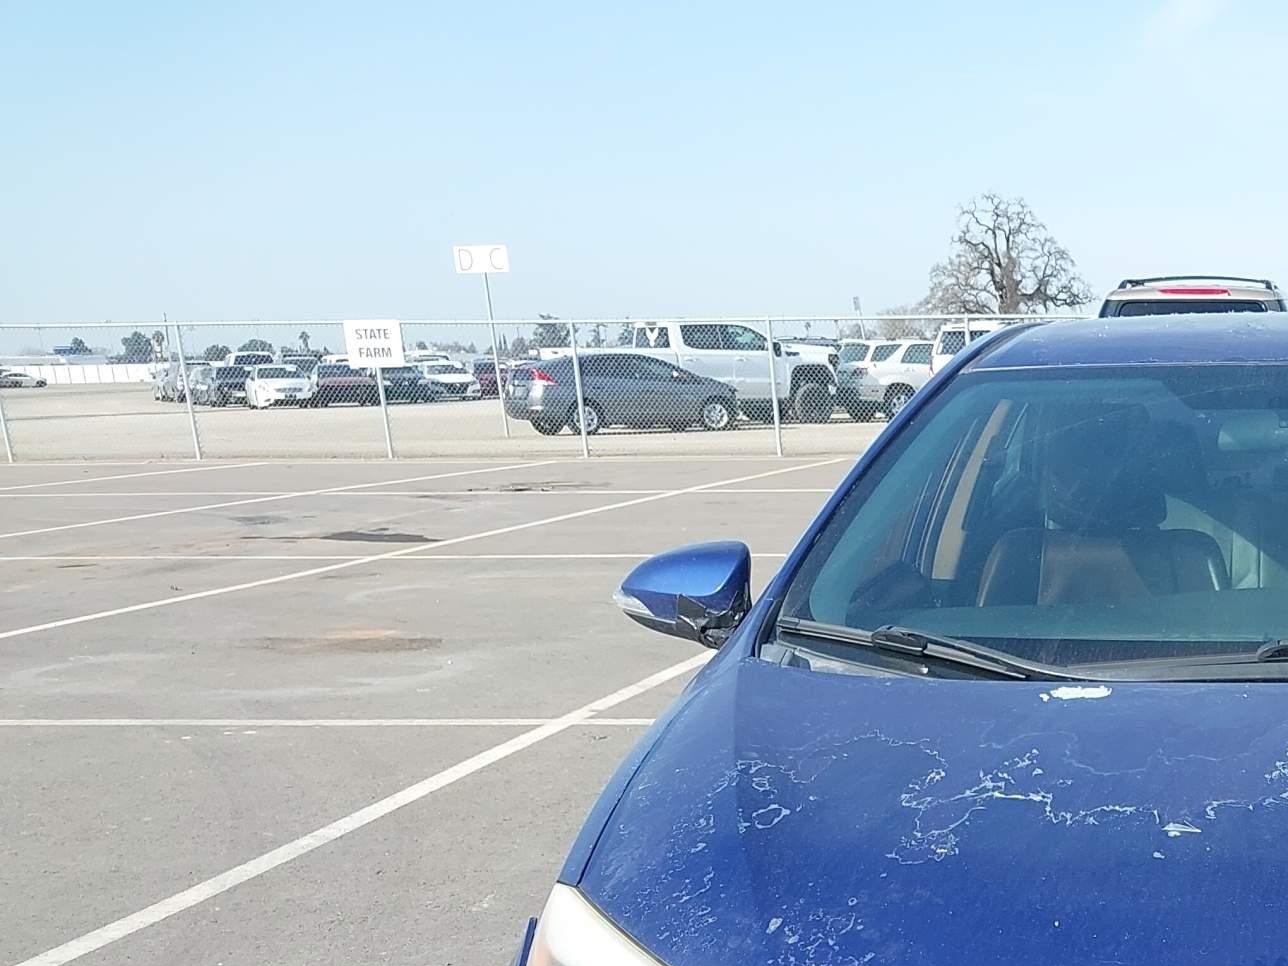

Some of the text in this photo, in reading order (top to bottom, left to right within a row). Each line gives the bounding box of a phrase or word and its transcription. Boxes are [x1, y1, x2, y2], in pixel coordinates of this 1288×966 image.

[458, 247, 474, 271] D
[355, 327, 391, 340] STATE
[358, 346, 393, 359] FARM
